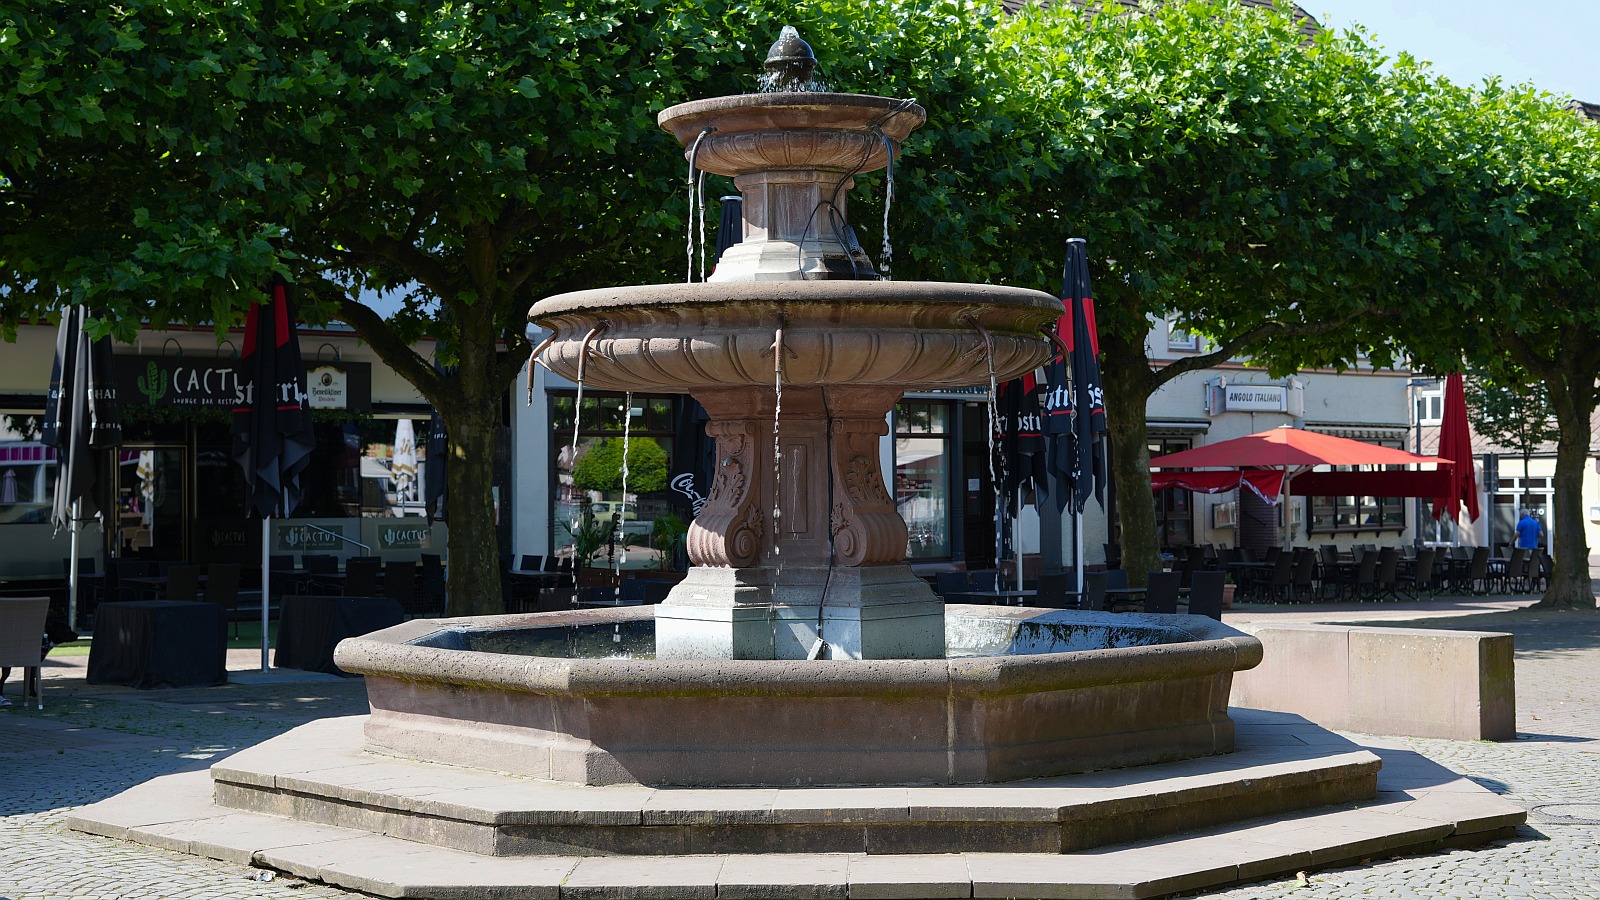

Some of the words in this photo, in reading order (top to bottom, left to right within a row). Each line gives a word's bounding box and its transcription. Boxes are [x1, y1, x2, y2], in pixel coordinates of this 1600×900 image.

[1229, 392, 1253, 402] ANGOLO
[1254, 393, 1282, 403] ITALIANO
[300, 531, 336, 542] CACTUS
[397, 529, 427, 541] CACTUS
